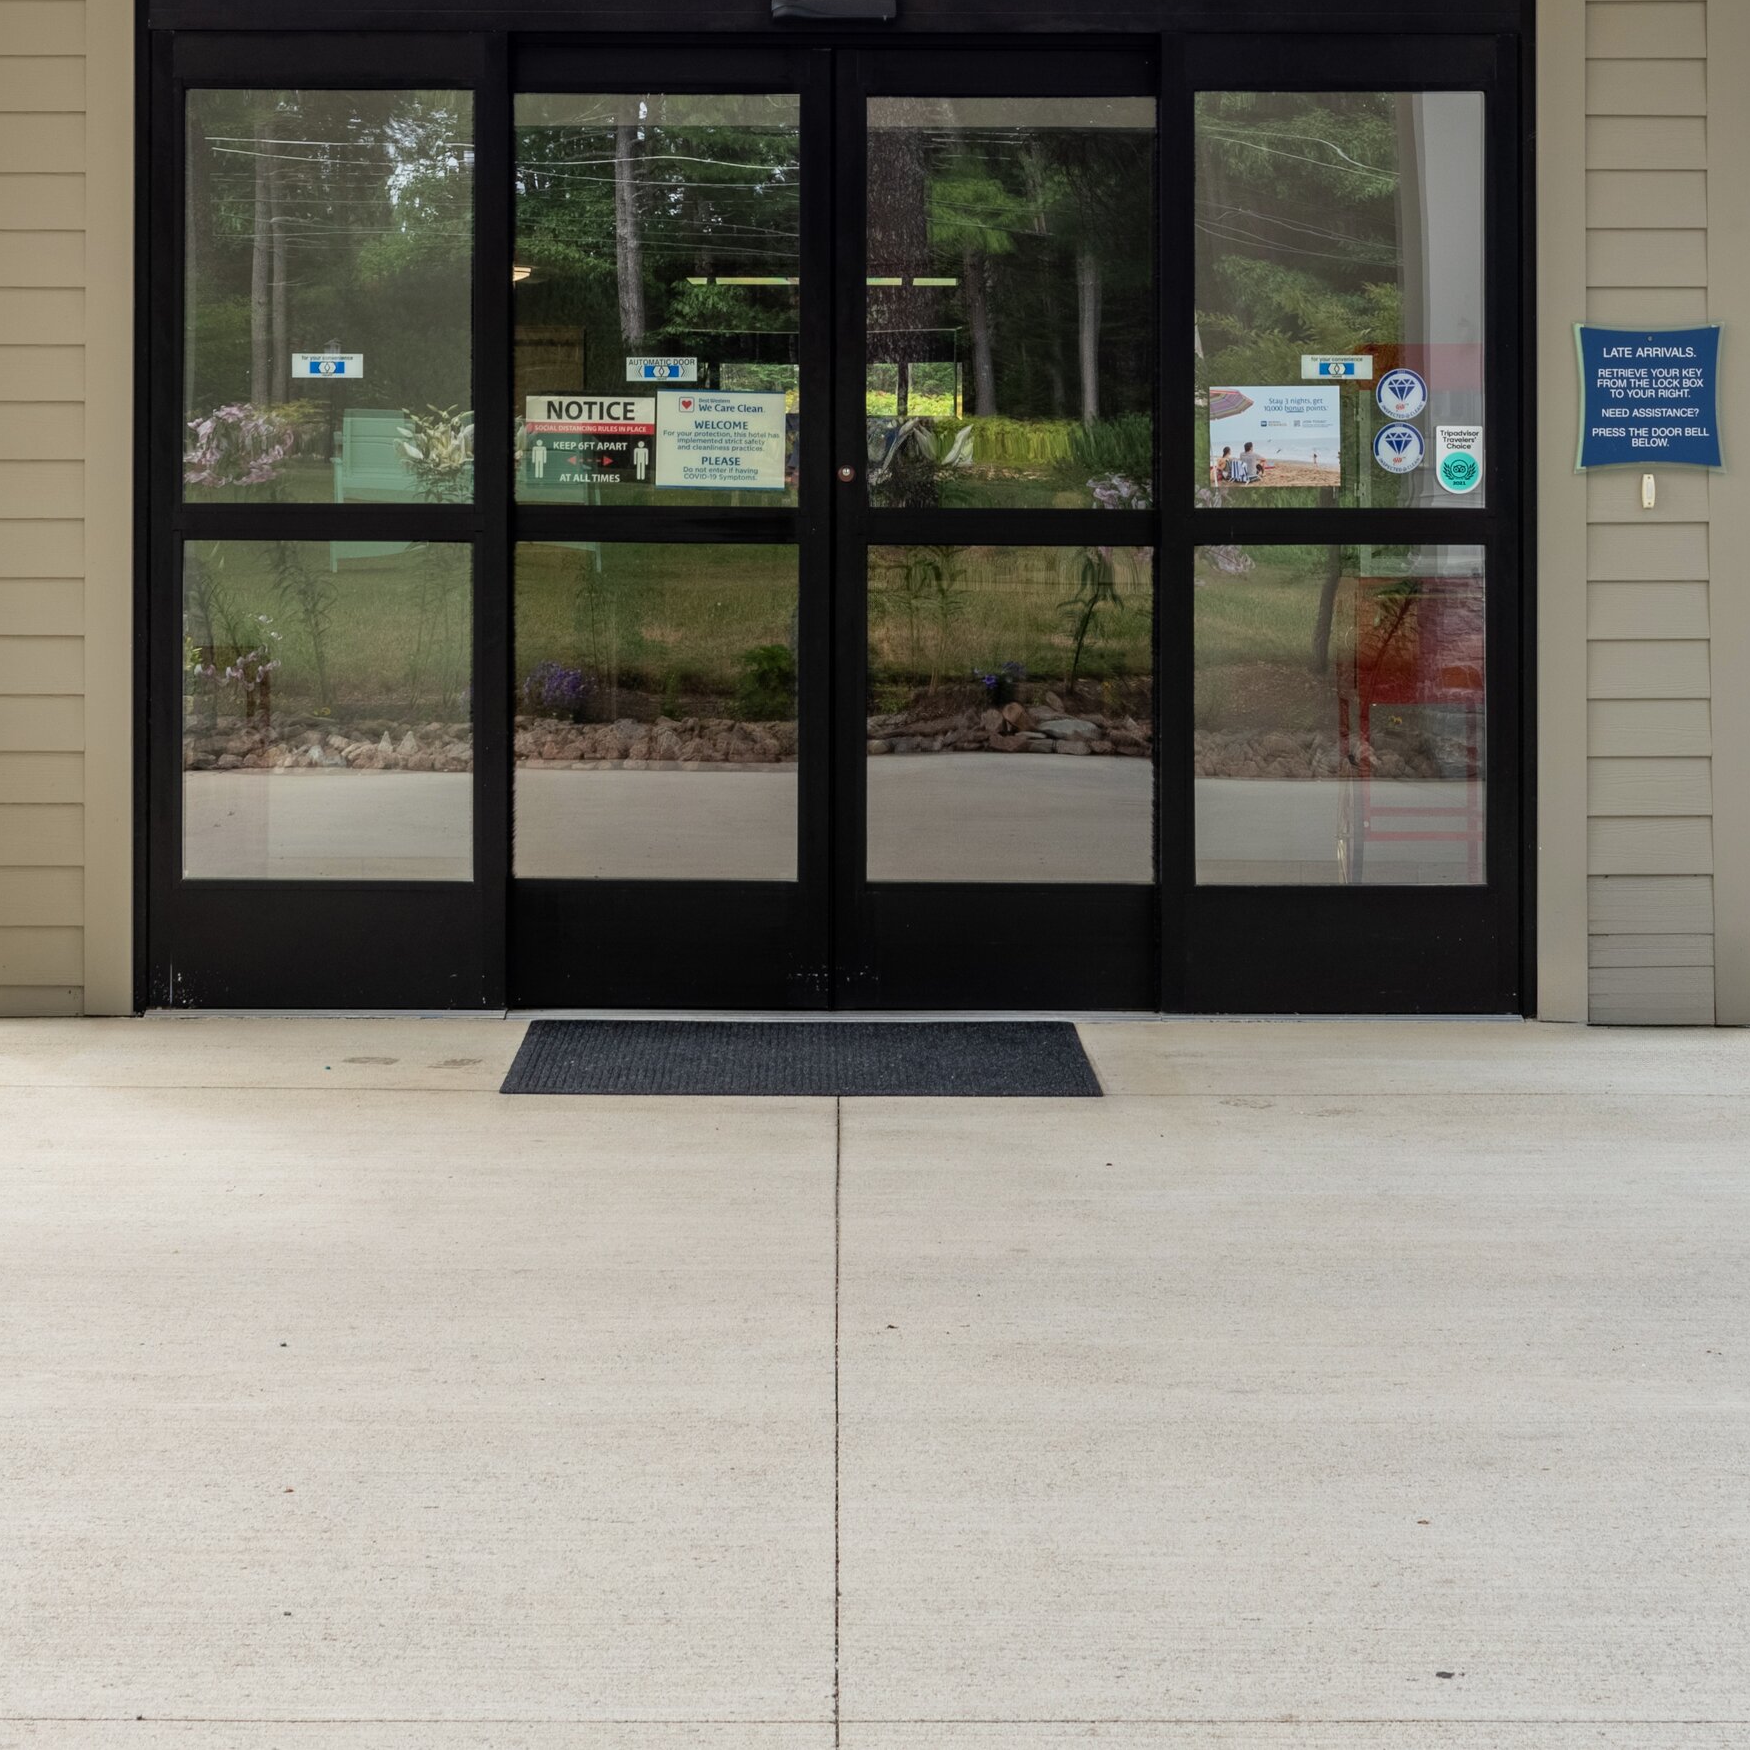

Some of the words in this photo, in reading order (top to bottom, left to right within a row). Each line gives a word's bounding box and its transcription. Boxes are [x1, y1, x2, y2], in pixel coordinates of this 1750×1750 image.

[1603, 347, 1632, 358] LATE
[1636, 347, 1696, 358] ARRIVALS.
[1598, 369, 1647, 377] RETRIEVE
[1650, 369, 1679, 377] YOUR
[1682, 368, 1702, 377] KEY
[1597, 379, 1626, 388] FROM
[1630, 379, 1649, 388] THE
[1653, 379, 1679, 388] LOCK
[1682, 379, 1703, 387] BOX
[1610, 389, 1624, 398] TO
[1627, 389, 1655, 398] YOUR
[1658, 389, 1691, 398] RIGHT.
[1290, 397, 1312, 405] nights,
[547, 401, 635, 421] NOTICE
[699, 404, 712, 412] We
[714, 404, 736, 412] Care
[1602, 408, 1629, 417] NEED
[1632, 408, 1699, 417] ASSISTANCE?
[694, 421, 748, 430] WELCOME
[694, 430, 732, 438] protection,
[1592, 428, 1626, 437] PRESS
[1629, 428, 1649, 437] THE
[1652, 428, 1682, 437] DOOR
[1685, 428, 1709, 436] BELL
[553, 442, 576, 450] KEEP
[578, 442, 595, 450] 6FT
[597, 442, 628, 450] APART
[677, 437, 723, 445] implemented
[744, 438, 765, 446] safety
[1632, 438, 1669, 447] BELOW.
[701, 457, 741, 466] PLEASE
[735, 467, 758, 475] having
[559, 474, 571, 482] AT
[573, 474, 590, 482] ALL
[592, 474, 620, 482] TIMES
